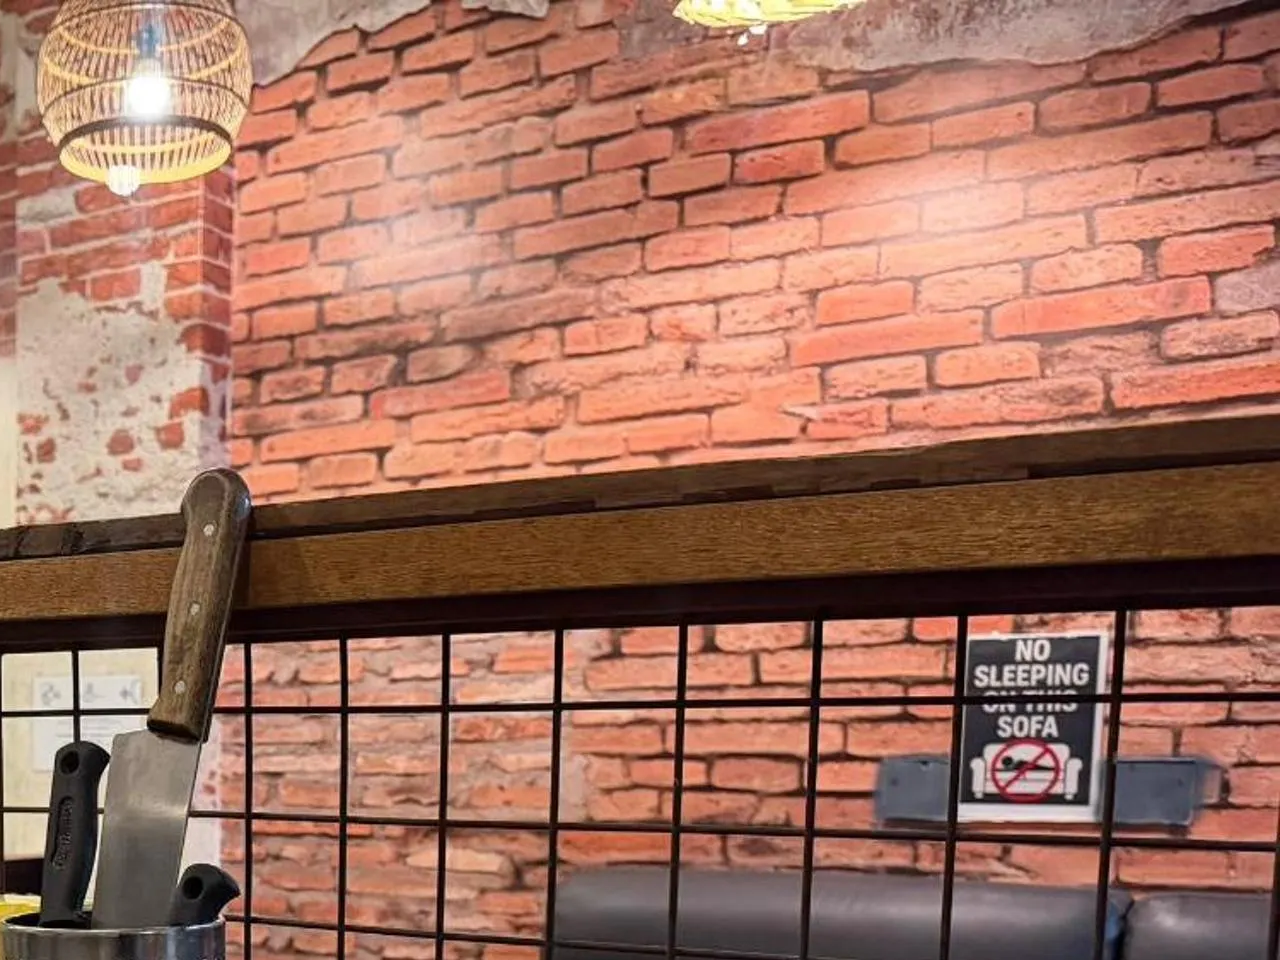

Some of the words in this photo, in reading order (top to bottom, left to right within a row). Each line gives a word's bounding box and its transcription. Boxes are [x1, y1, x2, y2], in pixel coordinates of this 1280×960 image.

[1014, 639, 1051, 662] NO
[974, 663, 1090, 688] SLEEPING
[996, 715, 1060, 738] SOFA
